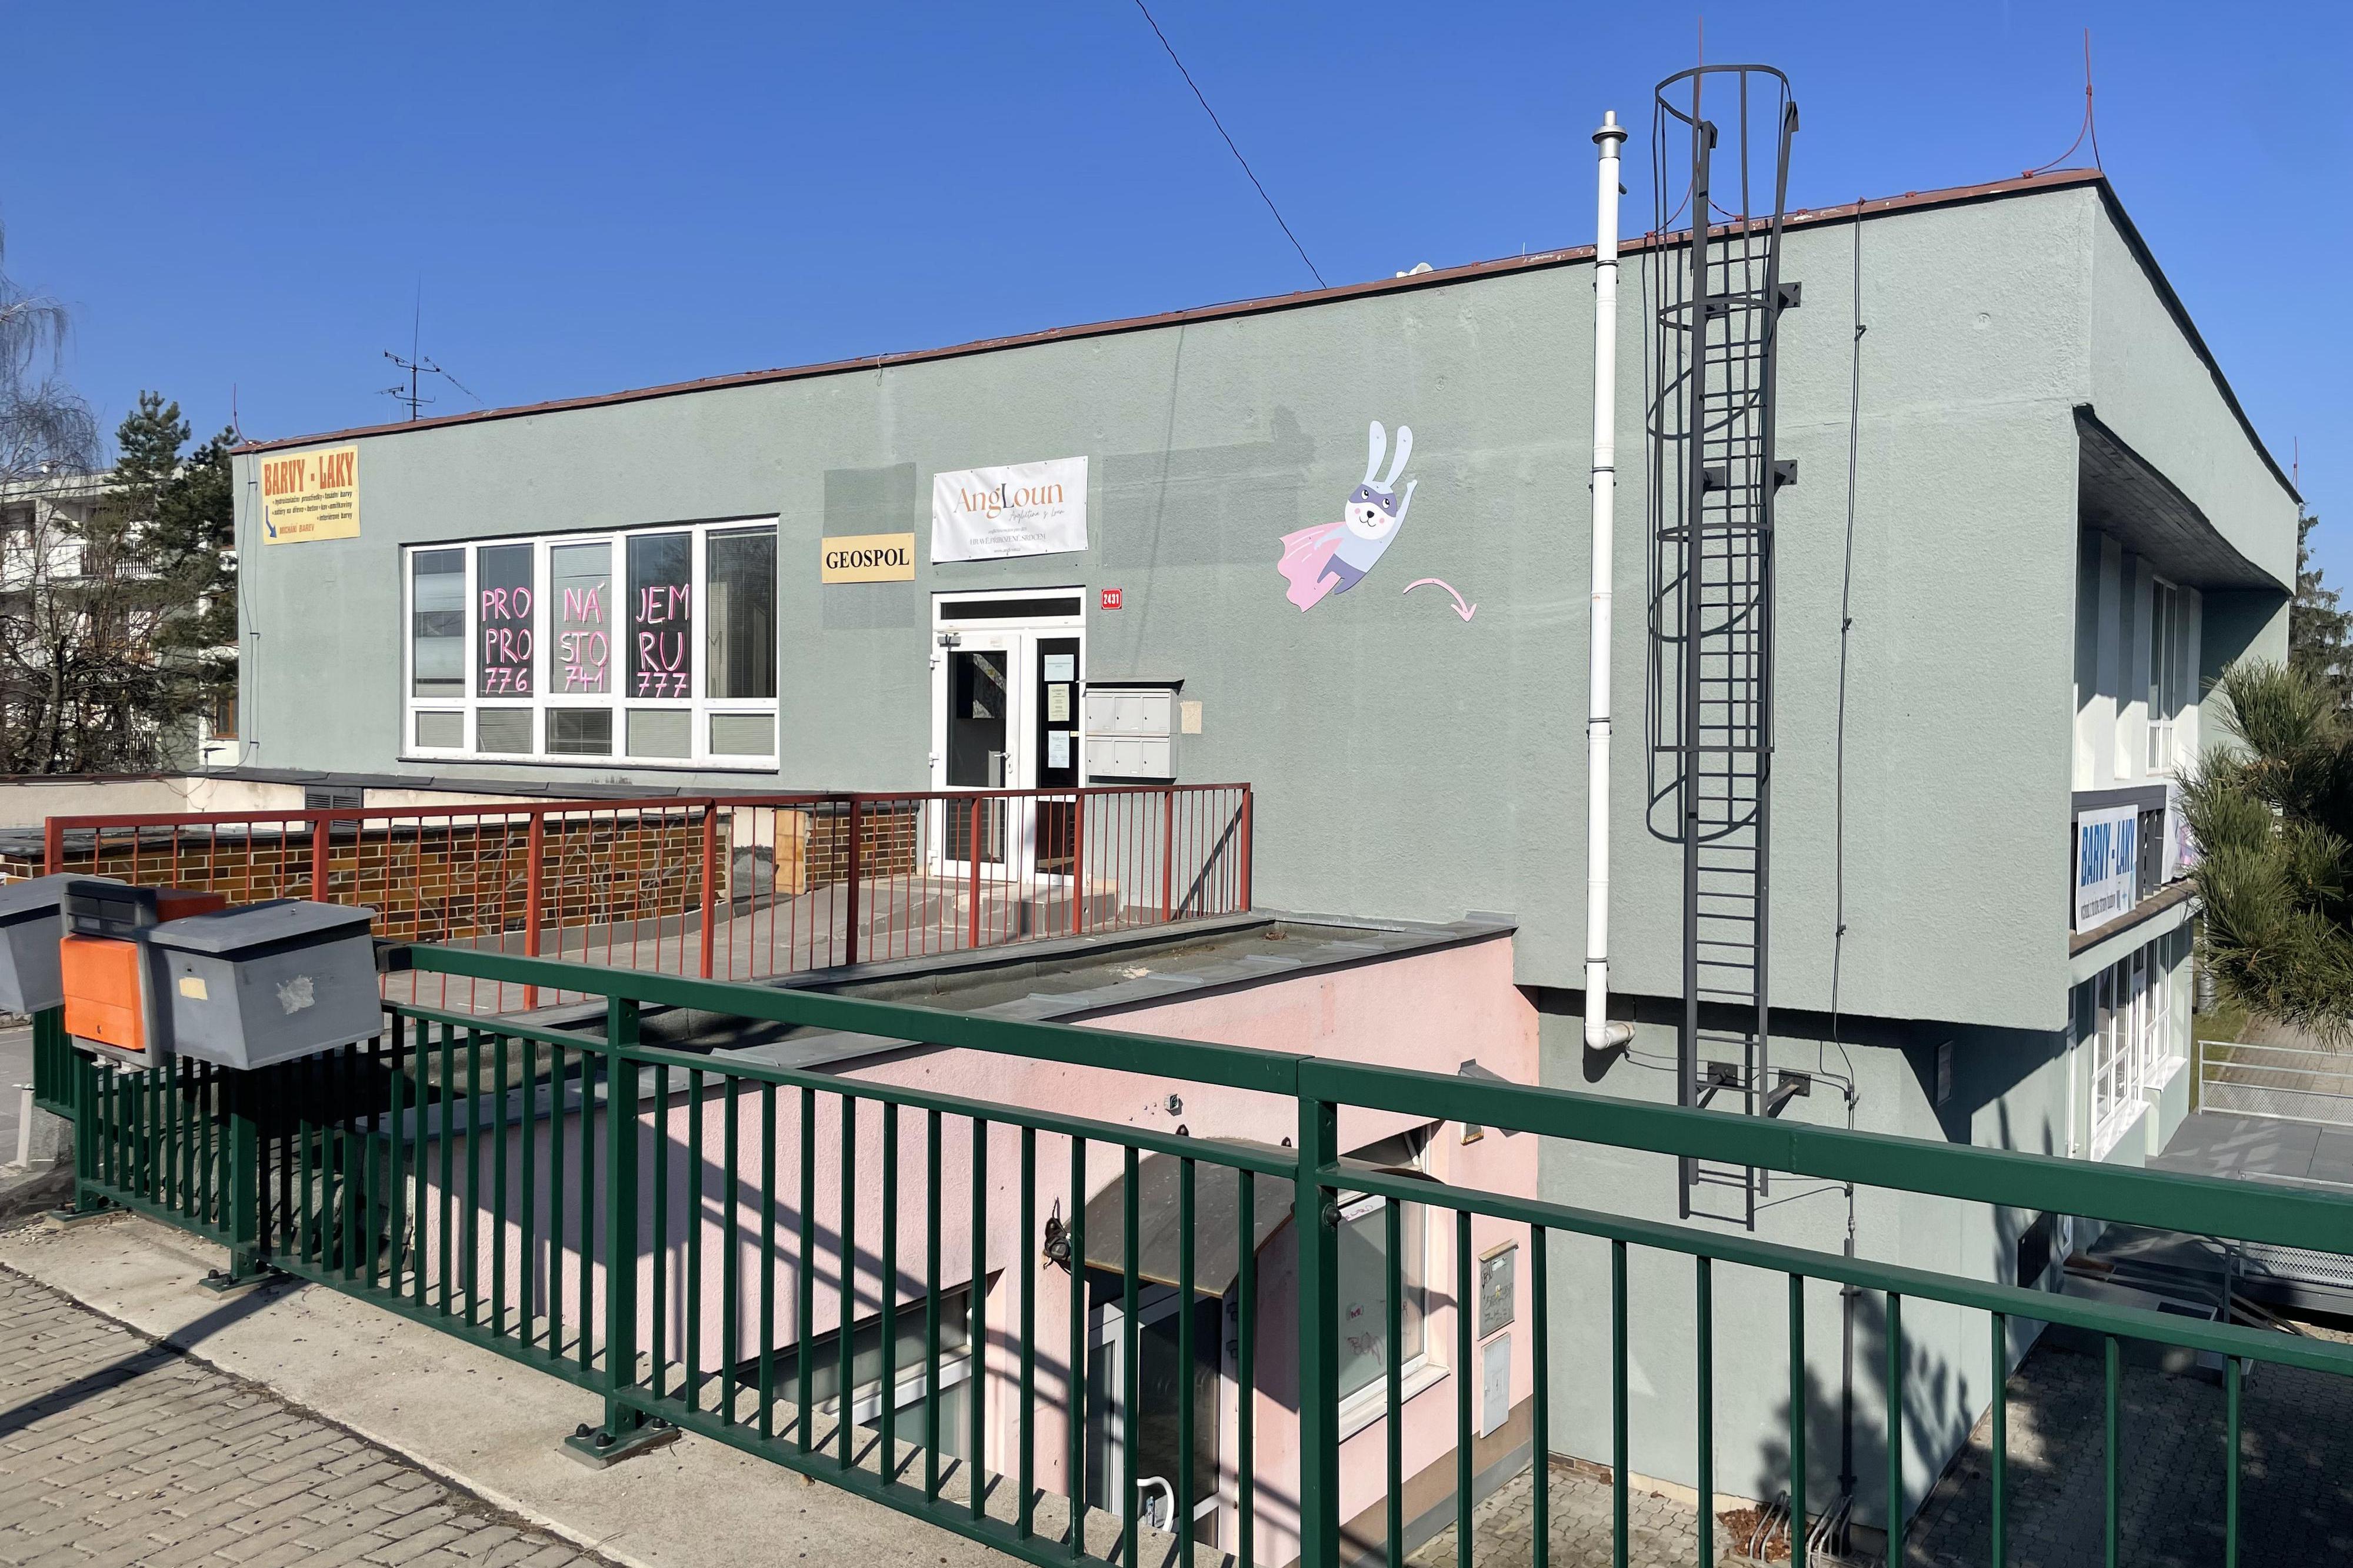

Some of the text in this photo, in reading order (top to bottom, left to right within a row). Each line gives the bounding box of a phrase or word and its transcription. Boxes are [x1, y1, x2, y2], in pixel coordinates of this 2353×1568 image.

[264, 459, 305, 496] BARVY
[319, 452, 354, 489] LAKY
[953, 483, 1064, 519] AngLoun
[826, 548, 909, 569] GEOSPOL
[482, 587, 532, 622] PRO
[1104, 593, 1119, 605] 2431
[486, 628, 533, 665] PRO
[485, 665, 688, 698] 776 741 777
[2081, 822, 2111, 887] BARVY
[2116, 818, 2135, 876] LAKY
